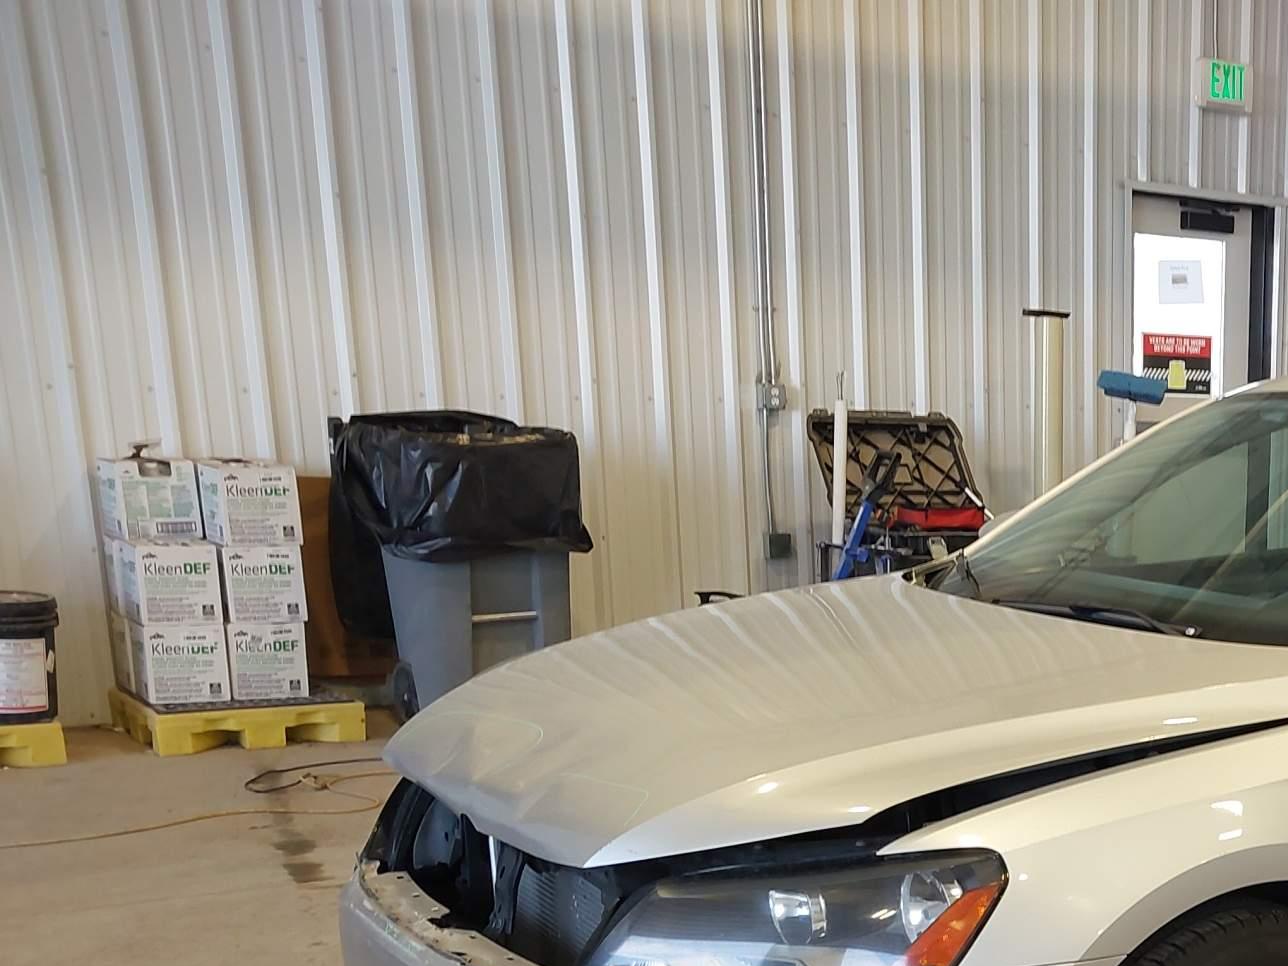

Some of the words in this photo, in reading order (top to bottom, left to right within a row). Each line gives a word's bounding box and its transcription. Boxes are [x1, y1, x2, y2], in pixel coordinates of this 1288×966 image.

[1211, 62, 1245, 101] EXIT
[1176, 336, 1183, 346] TO
[226, 484, 290, 497] KleenDEF
[143, 562, 211, 576] KleenDEF
[230, 563, 295, 576] KleenDEF
[151, 641, 218, 656] KleenDEF
[235, 639, 299, 653] KleenDEF
